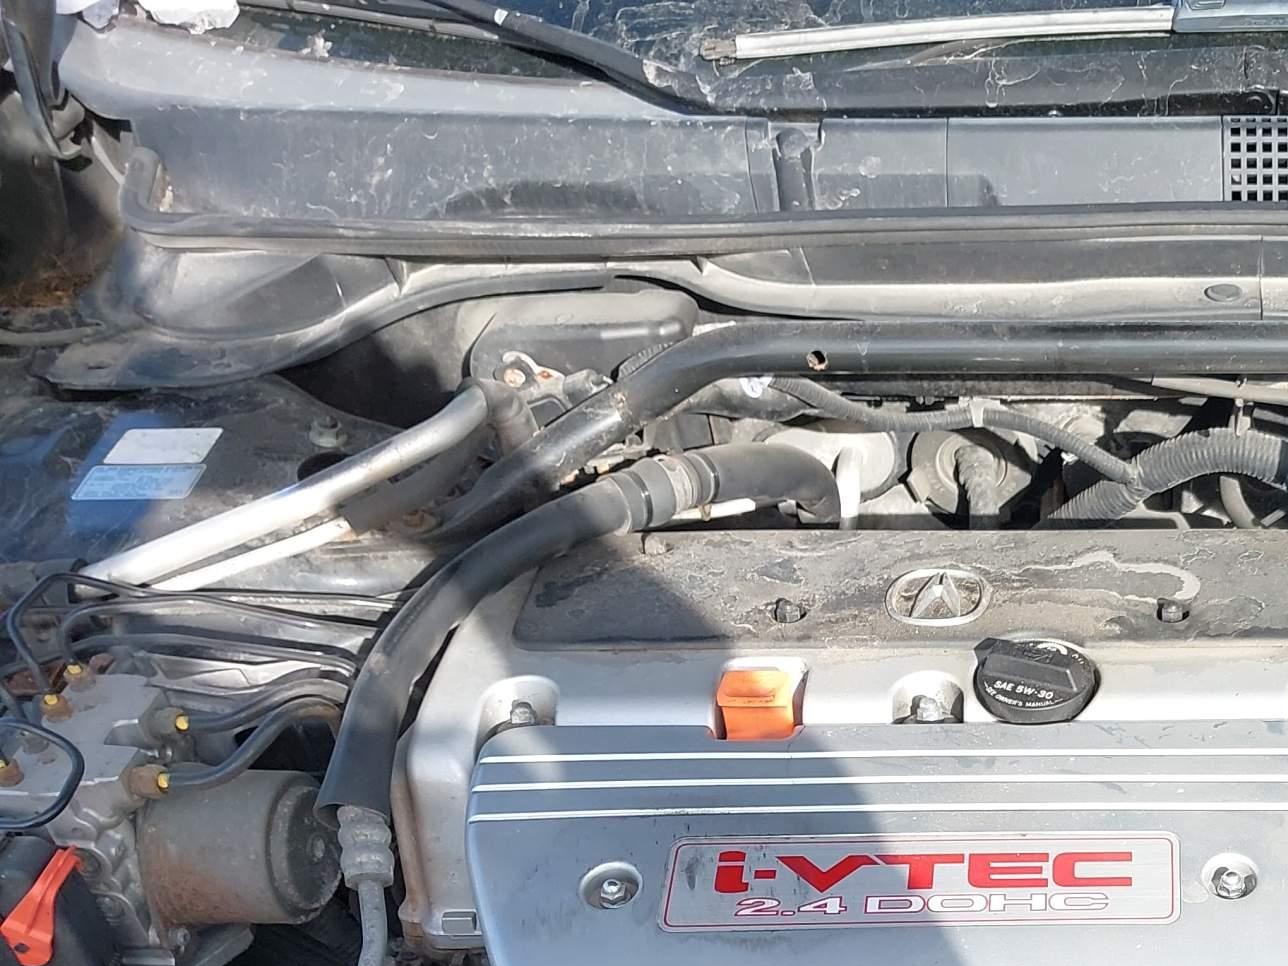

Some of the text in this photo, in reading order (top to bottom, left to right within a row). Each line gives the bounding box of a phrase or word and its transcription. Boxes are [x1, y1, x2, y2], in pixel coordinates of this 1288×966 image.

[993, 680, 1015, 692] SAE
[713, 850, 1133, 894] i-VTEC
[734, 892, 1109, 917] 2.4 DOHC
